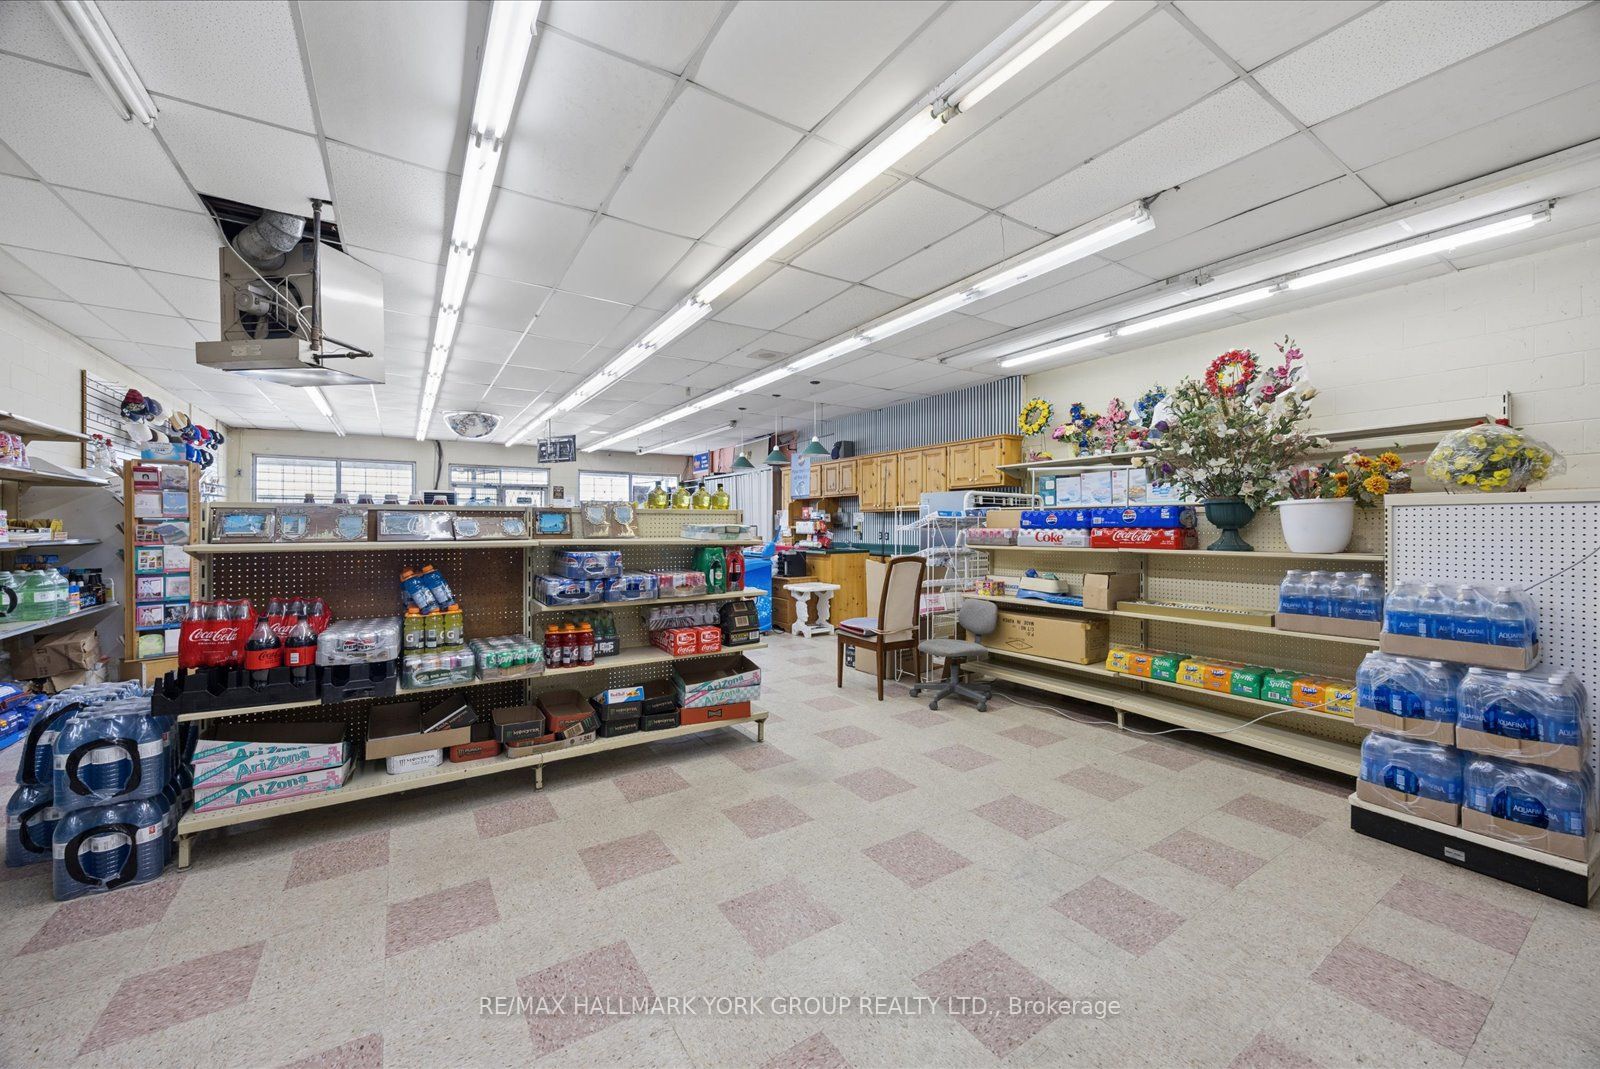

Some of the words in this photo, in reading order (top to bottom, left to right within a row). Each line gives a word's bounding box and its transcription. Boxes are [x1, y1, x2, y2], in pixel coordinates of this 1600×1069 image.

[1035, 531, 1064, 543] Coke
[1112, 529, 1152, 542] Coca-Cola
[188, 627, 240, 642] Coca-Cola
[406, 633, 414, 643] G
[1233, 672, 1254, 682] Sprite
[1268, 679, 1291, 689] Sprite
[235, 751, 310, 781] AriZona
[235, 774, 308, 805] AriZona
